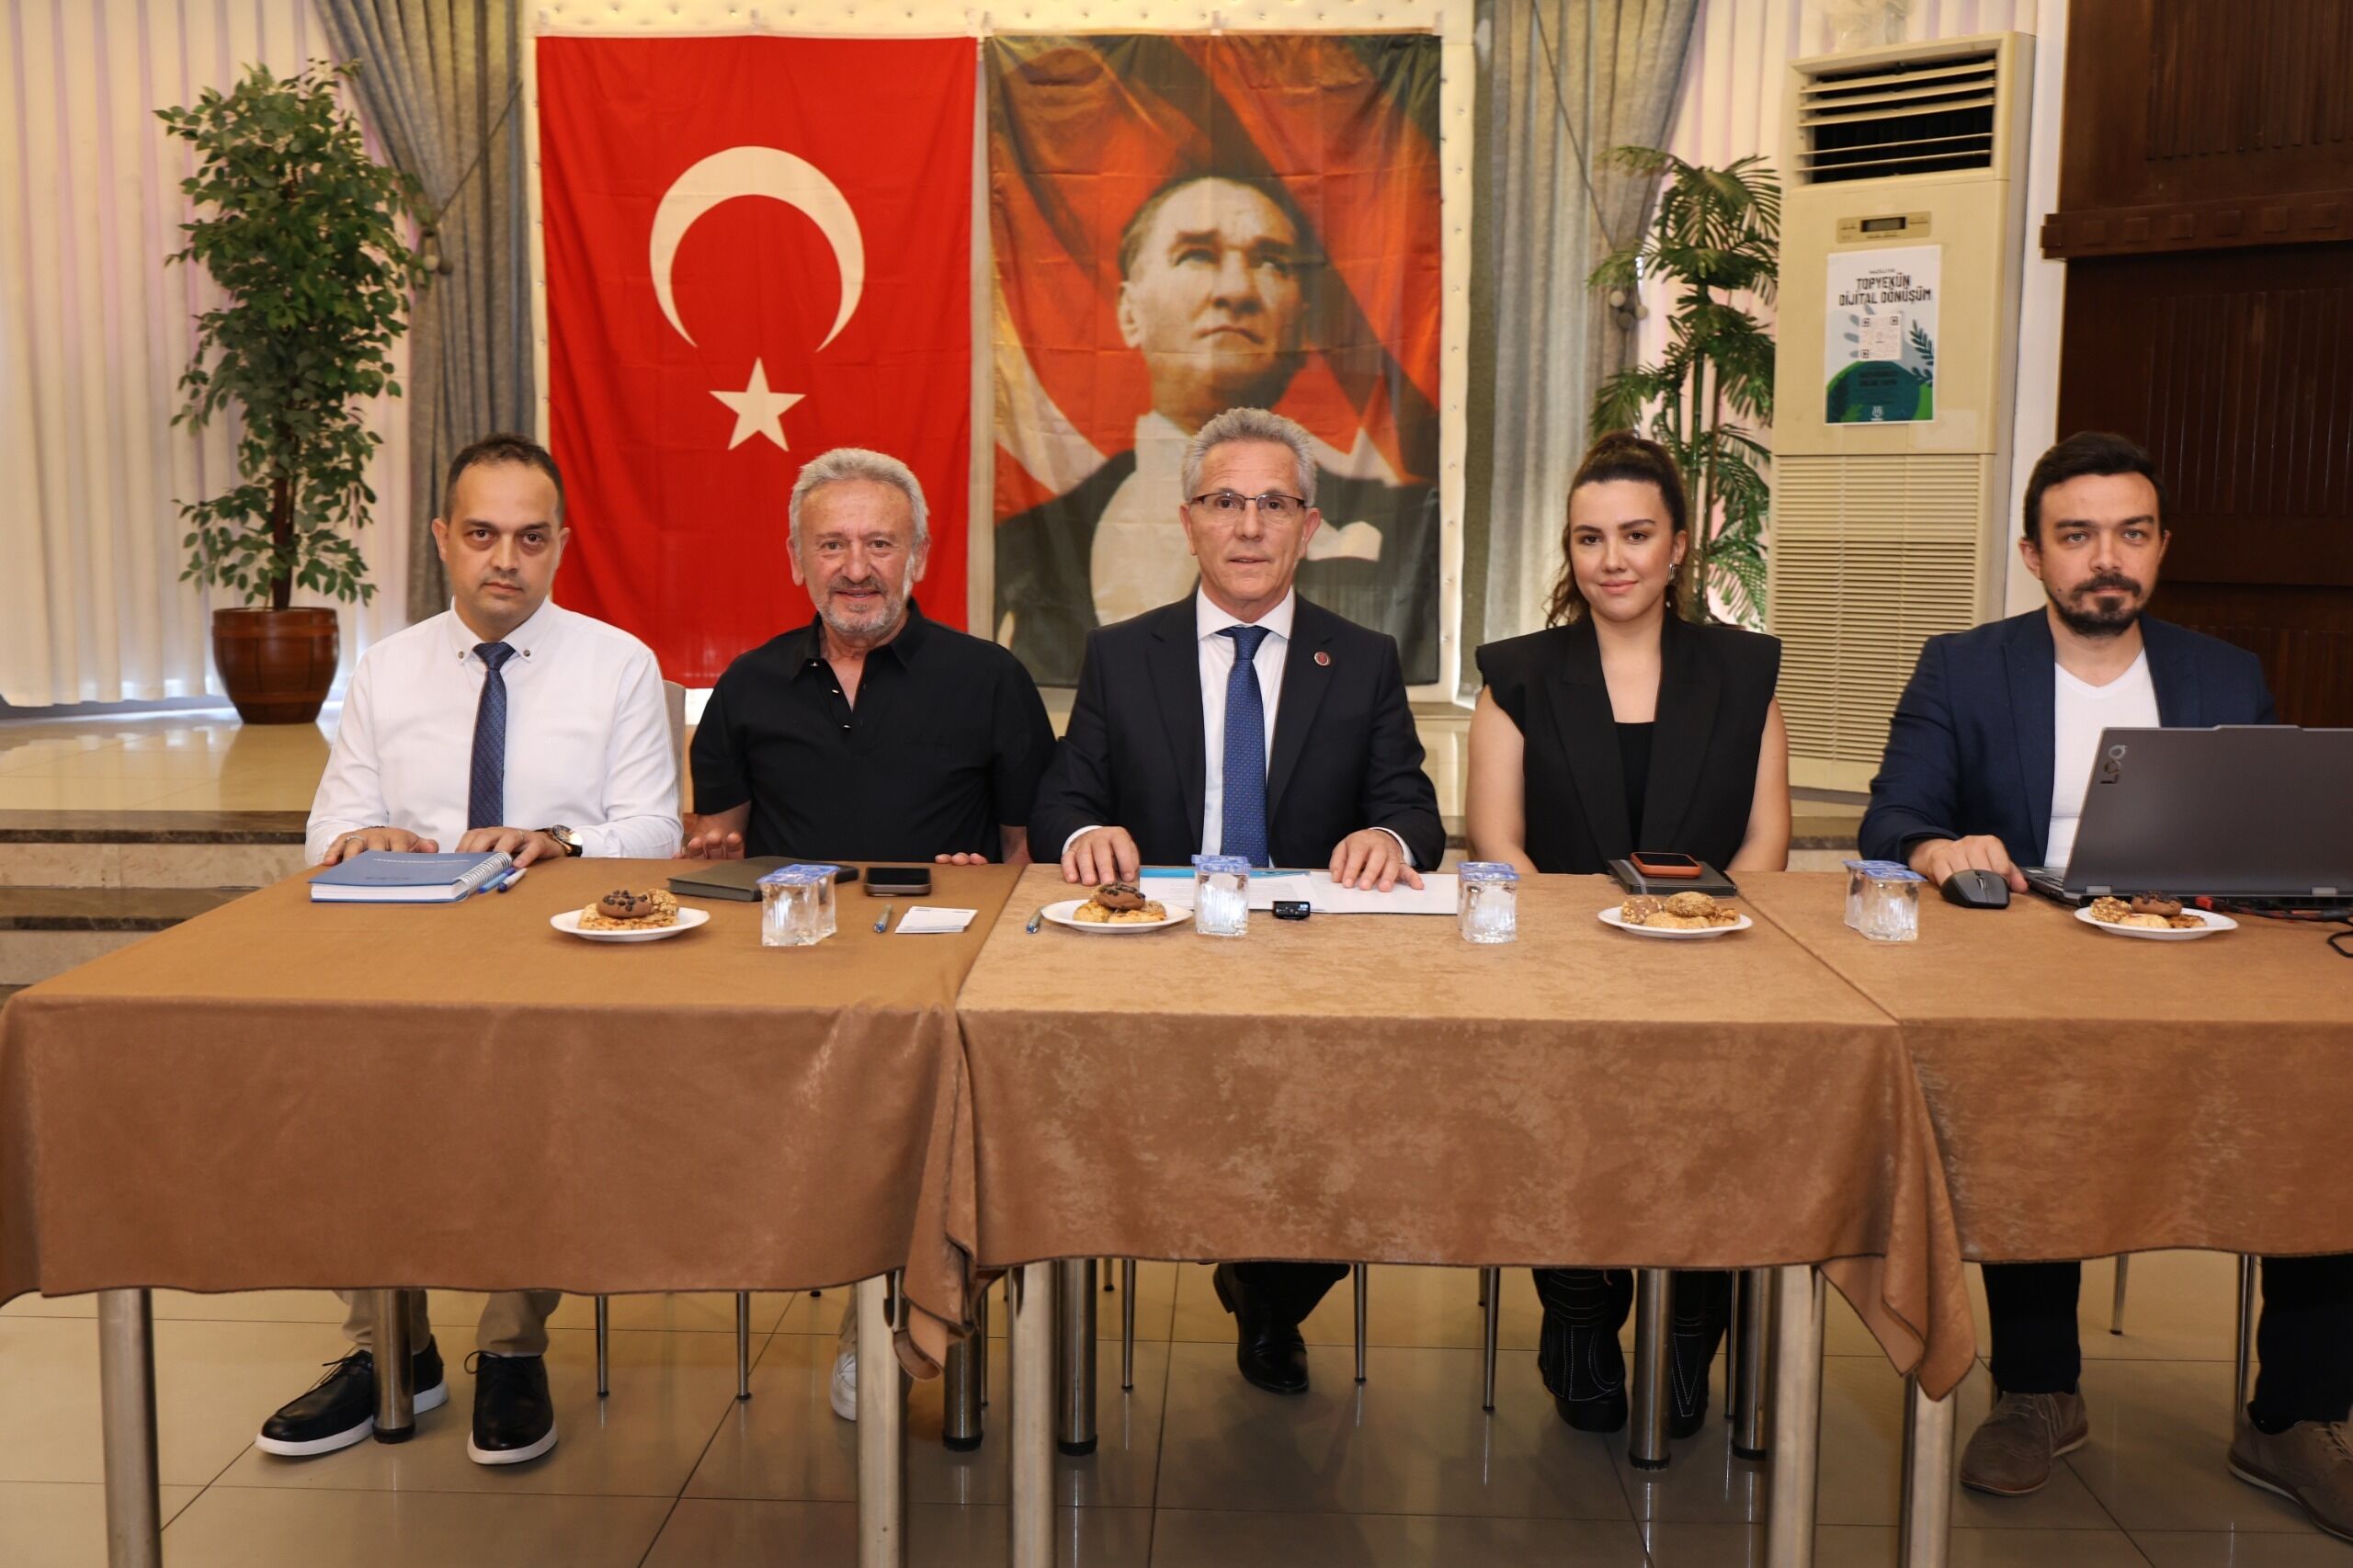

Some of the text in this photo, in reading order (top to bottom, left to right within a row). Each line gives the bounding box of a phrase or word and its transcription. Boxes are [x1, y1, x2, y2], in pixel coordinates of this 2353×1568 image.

[1839, 286, 1932, 306] DİJİTAL DÖNÜŞÜM
[2100, 744, 2128, 785] LOQ
